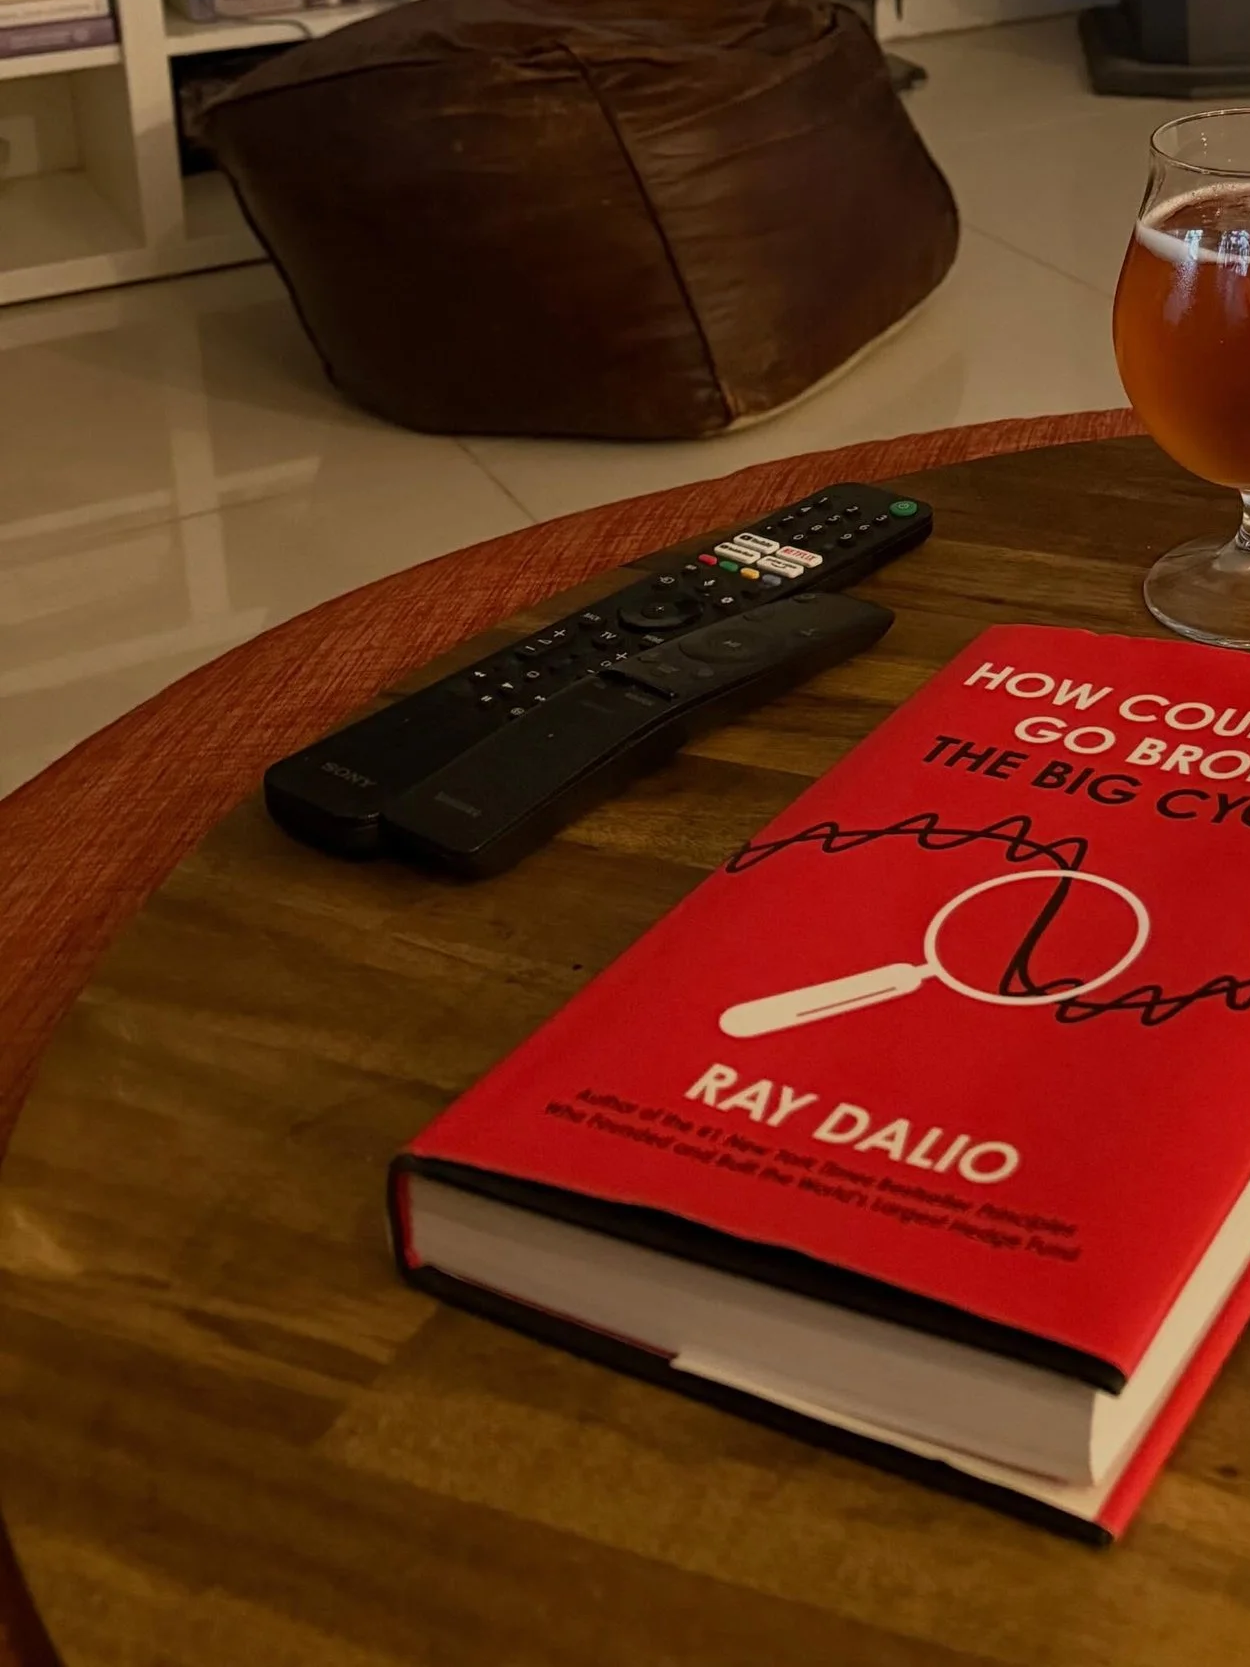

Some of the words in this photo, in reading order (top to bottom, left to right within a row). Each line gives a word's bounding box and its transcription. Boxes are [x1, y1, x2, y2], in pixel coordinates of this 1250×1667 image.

[963, 661, 1113, 711] HOW
[1013, 715, 1117, 755] GO
[322, 762, 378, 787] SONY
[922, 734, 1029, 780] THE
[1031, 759, 1143, 805] BIG
[684, 1062, 819, 1129] RAY
[812, 1102, 1021, 1184] DALIO
